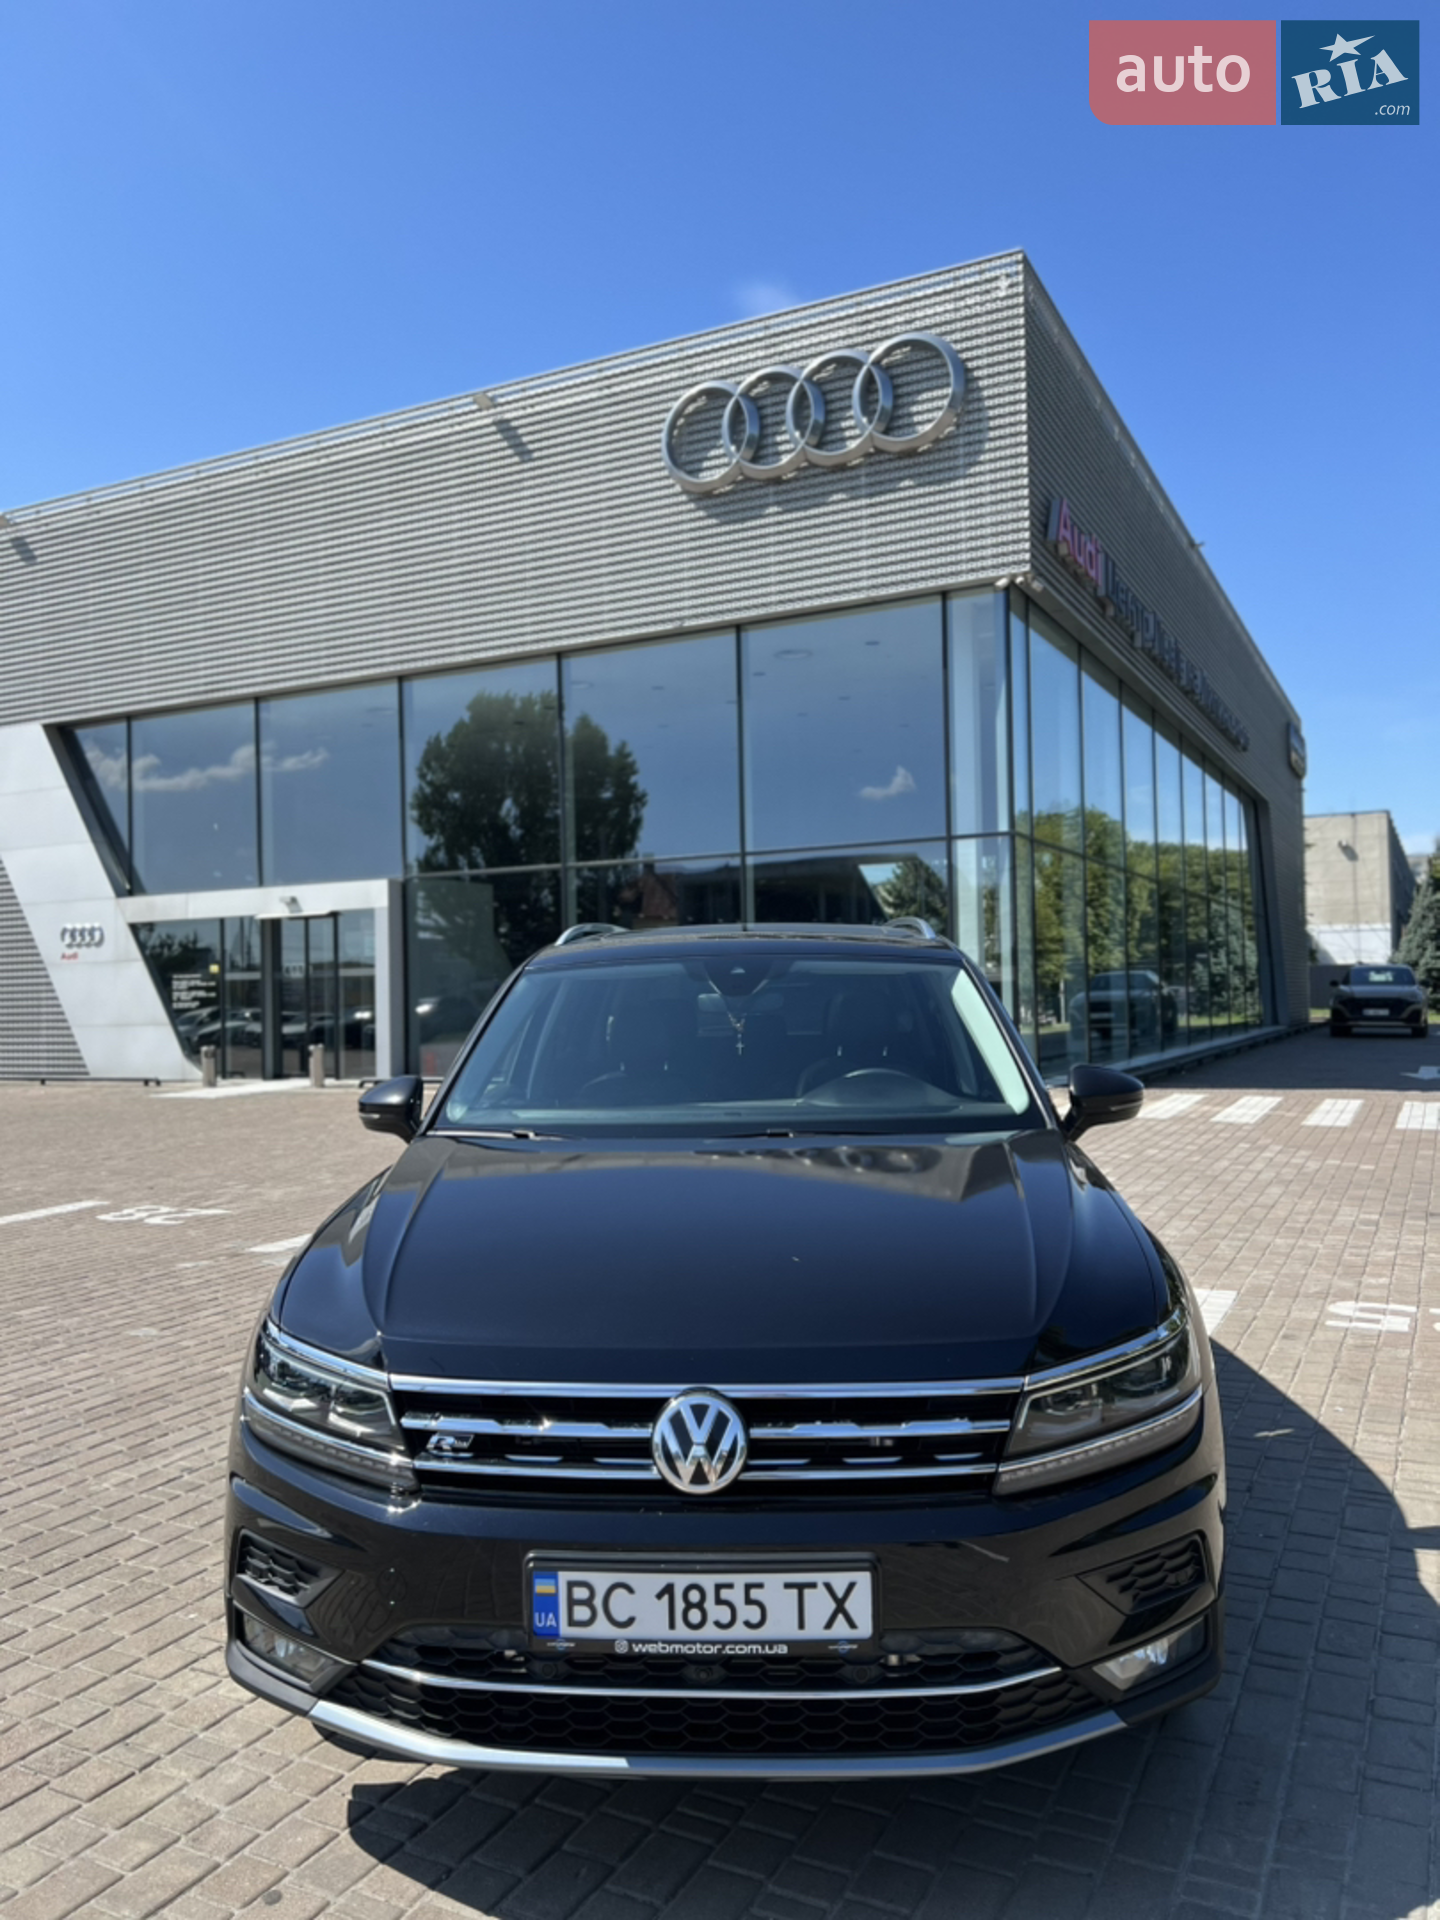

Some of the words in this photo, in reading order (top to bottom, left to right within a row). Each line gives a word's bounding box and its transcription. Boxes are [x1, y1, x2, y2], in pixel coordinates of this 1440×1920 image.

[1057, 497, 1102, 589] Audi
[535, 1612, 558, 1628] UA
[566, 1580, 637, 1629] BC
[655, 1582, 768, 1631] 1855
[783, 1581, 858, 1631] TX
[632, 1641, 788, 1655] webmotor.com.ua
